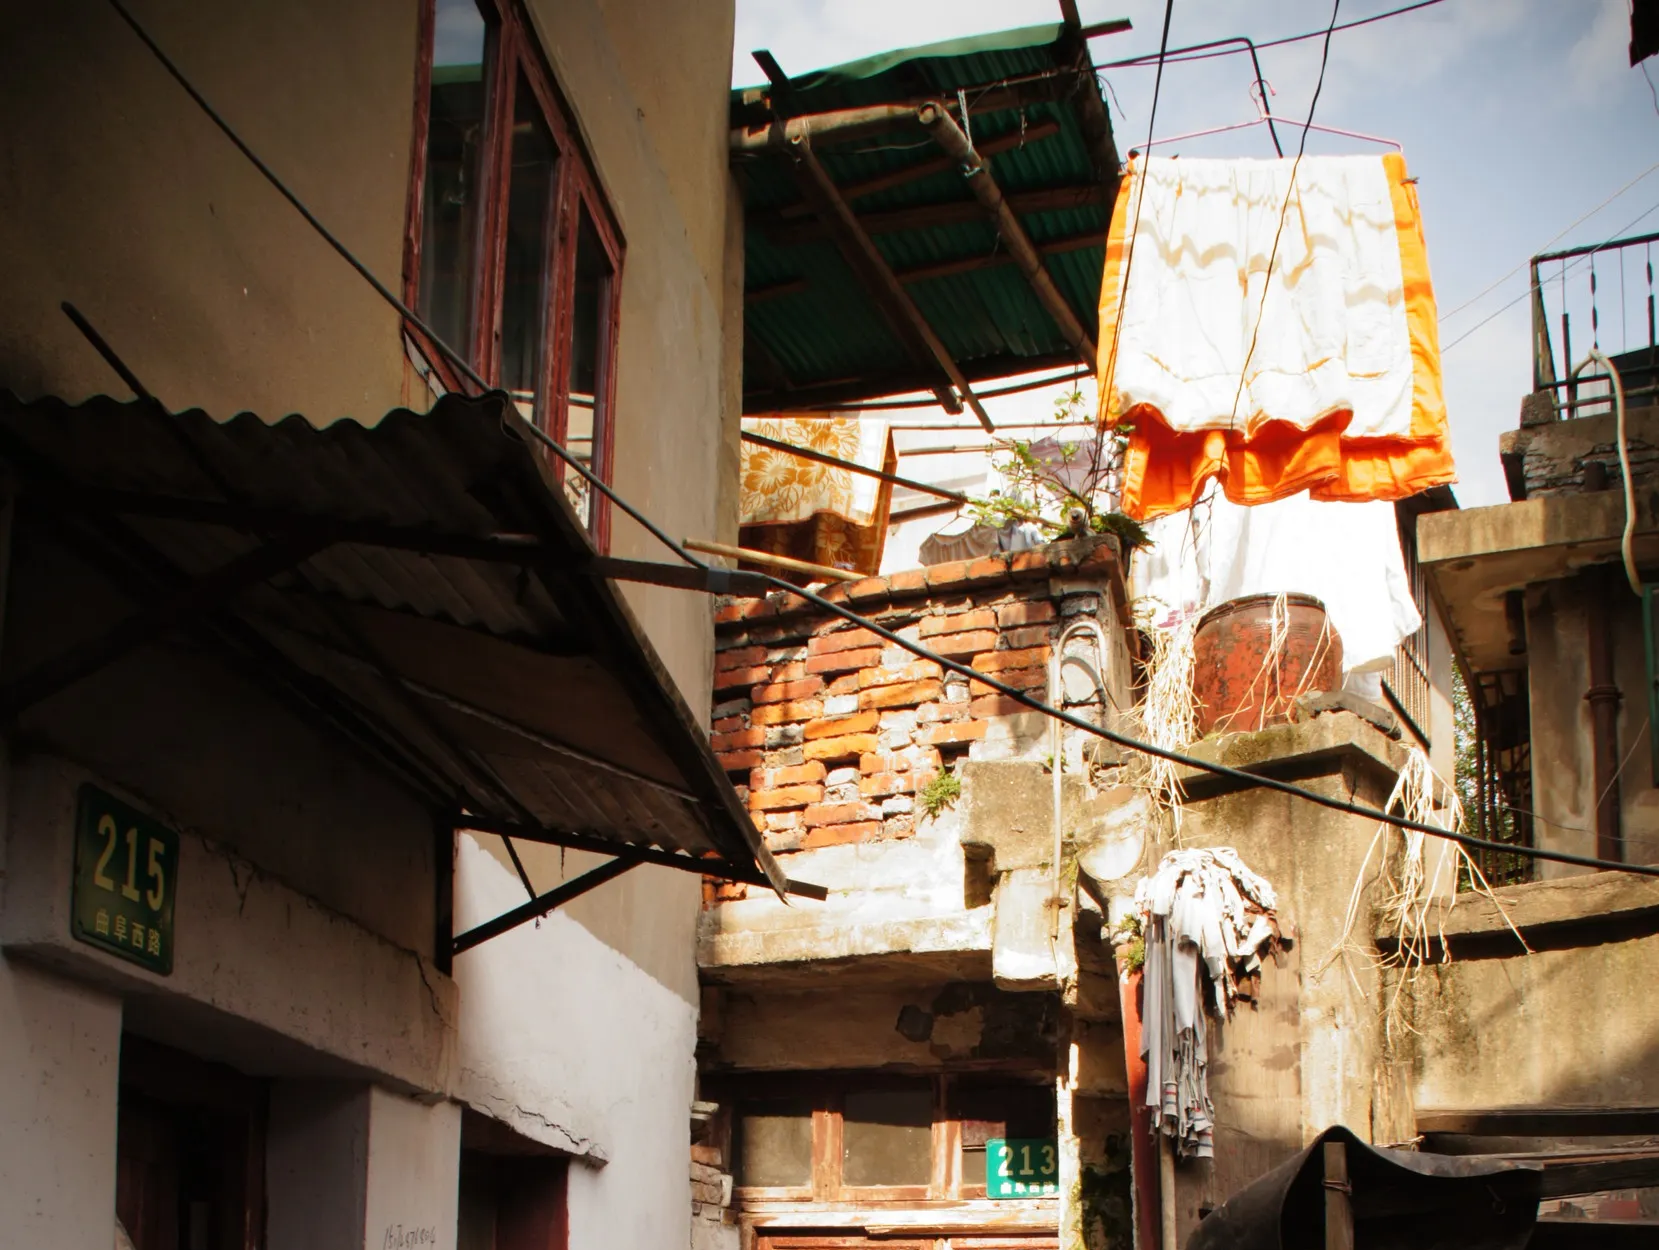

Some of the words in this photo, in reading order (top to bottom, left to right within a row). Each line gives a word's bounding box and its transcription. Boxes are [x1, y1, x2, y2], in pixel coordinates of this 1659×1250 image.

[94, 814, 165, 911] 215
[95, 908, 161, 957] 曲阜西路
[998, 1145, 1056, 1176] 213
